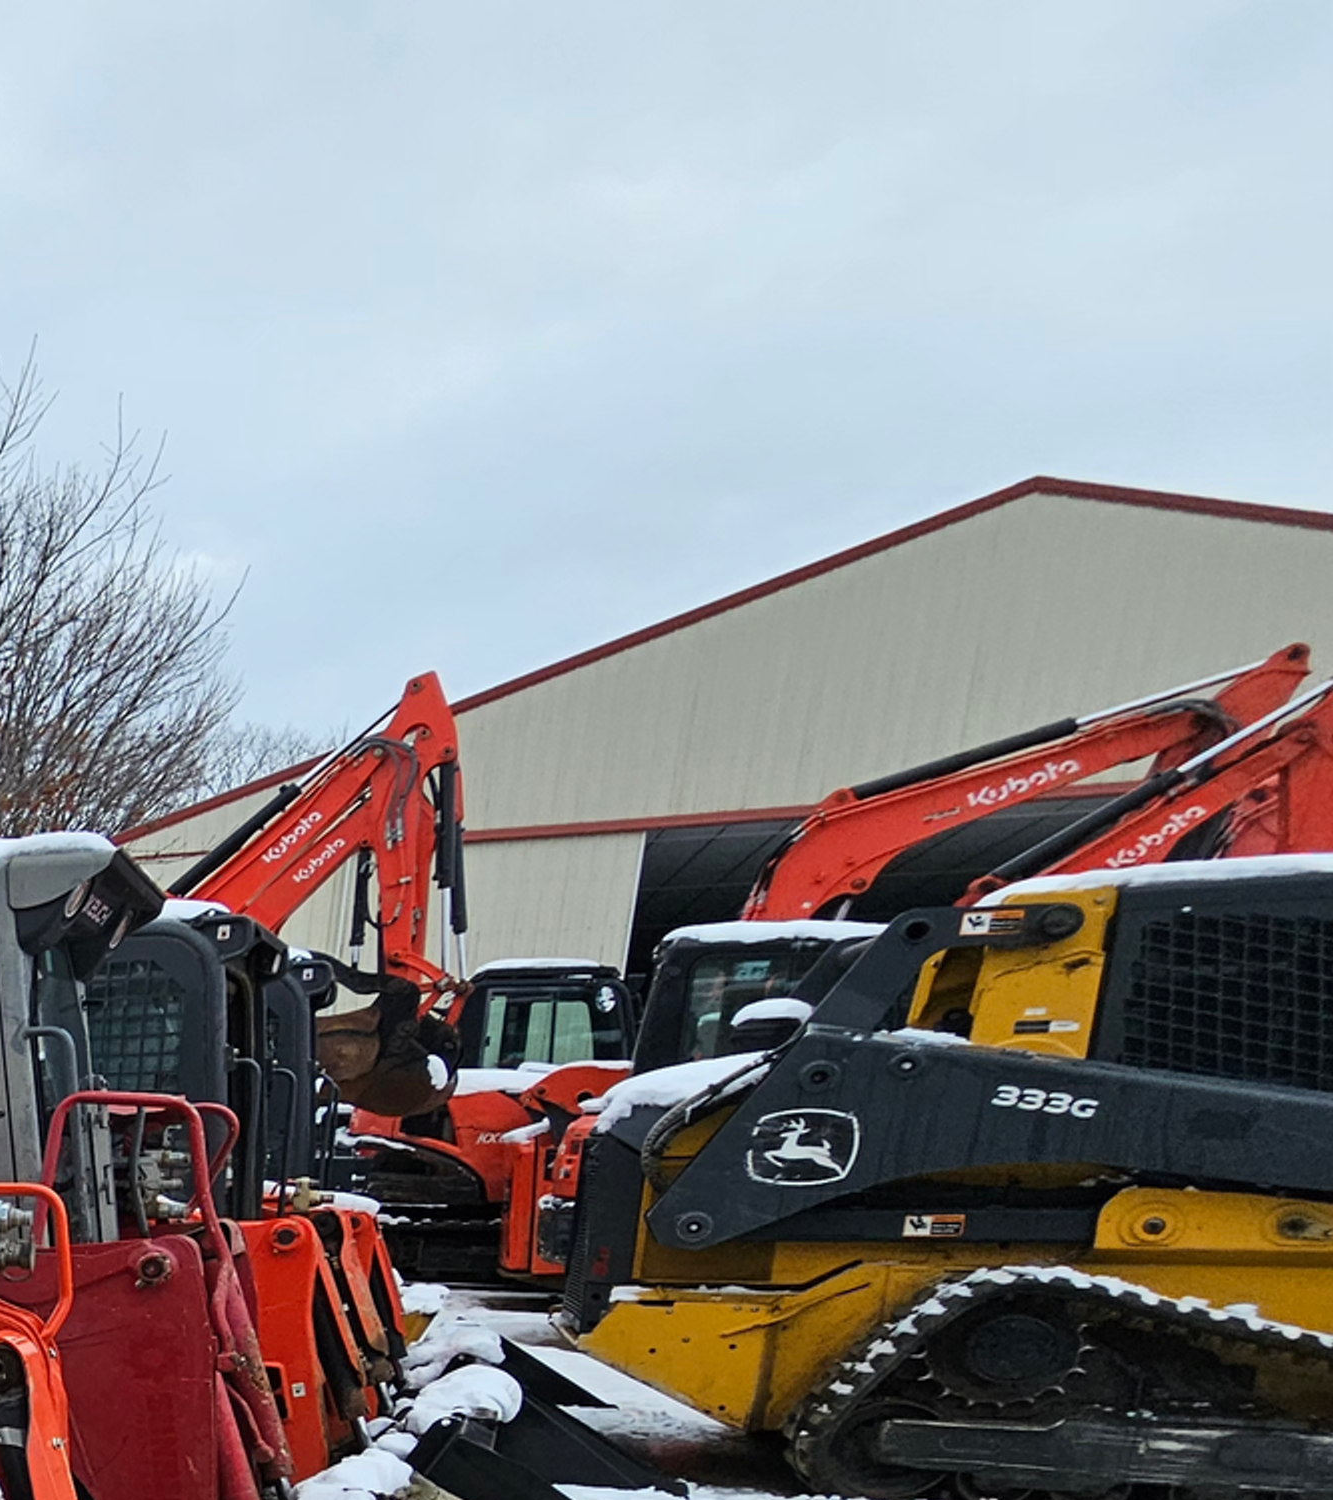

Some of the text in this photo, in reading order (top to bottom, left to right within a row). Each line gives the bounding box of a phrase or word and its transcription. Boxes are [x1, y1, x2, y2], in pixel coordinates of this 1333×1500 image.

[966, 759, 1080, 807] Kubota
[260, 811, 323, 863] Kubota
[292, 838, 347, 883] Kubota
[1105, 805, 1207, 868] Kubota
[991, 1085, 1100, 1118] 333G
